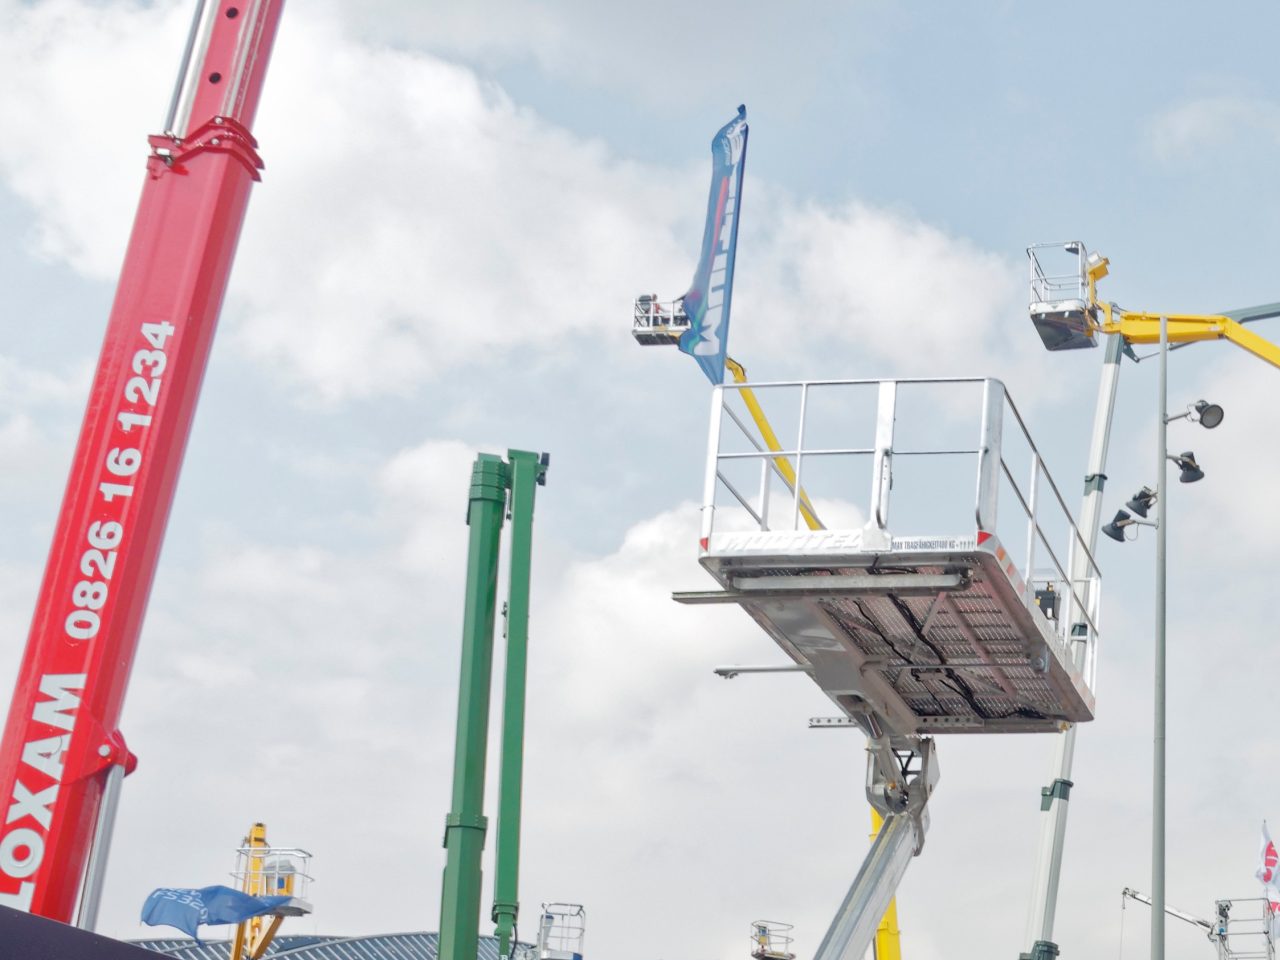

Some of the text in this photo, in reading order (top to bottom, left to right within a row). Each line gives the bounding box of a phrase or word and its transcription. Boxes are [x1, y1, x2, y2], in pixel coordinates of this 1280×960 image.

[0, 320, 175, 912] LOXAM 0826 16 1234
